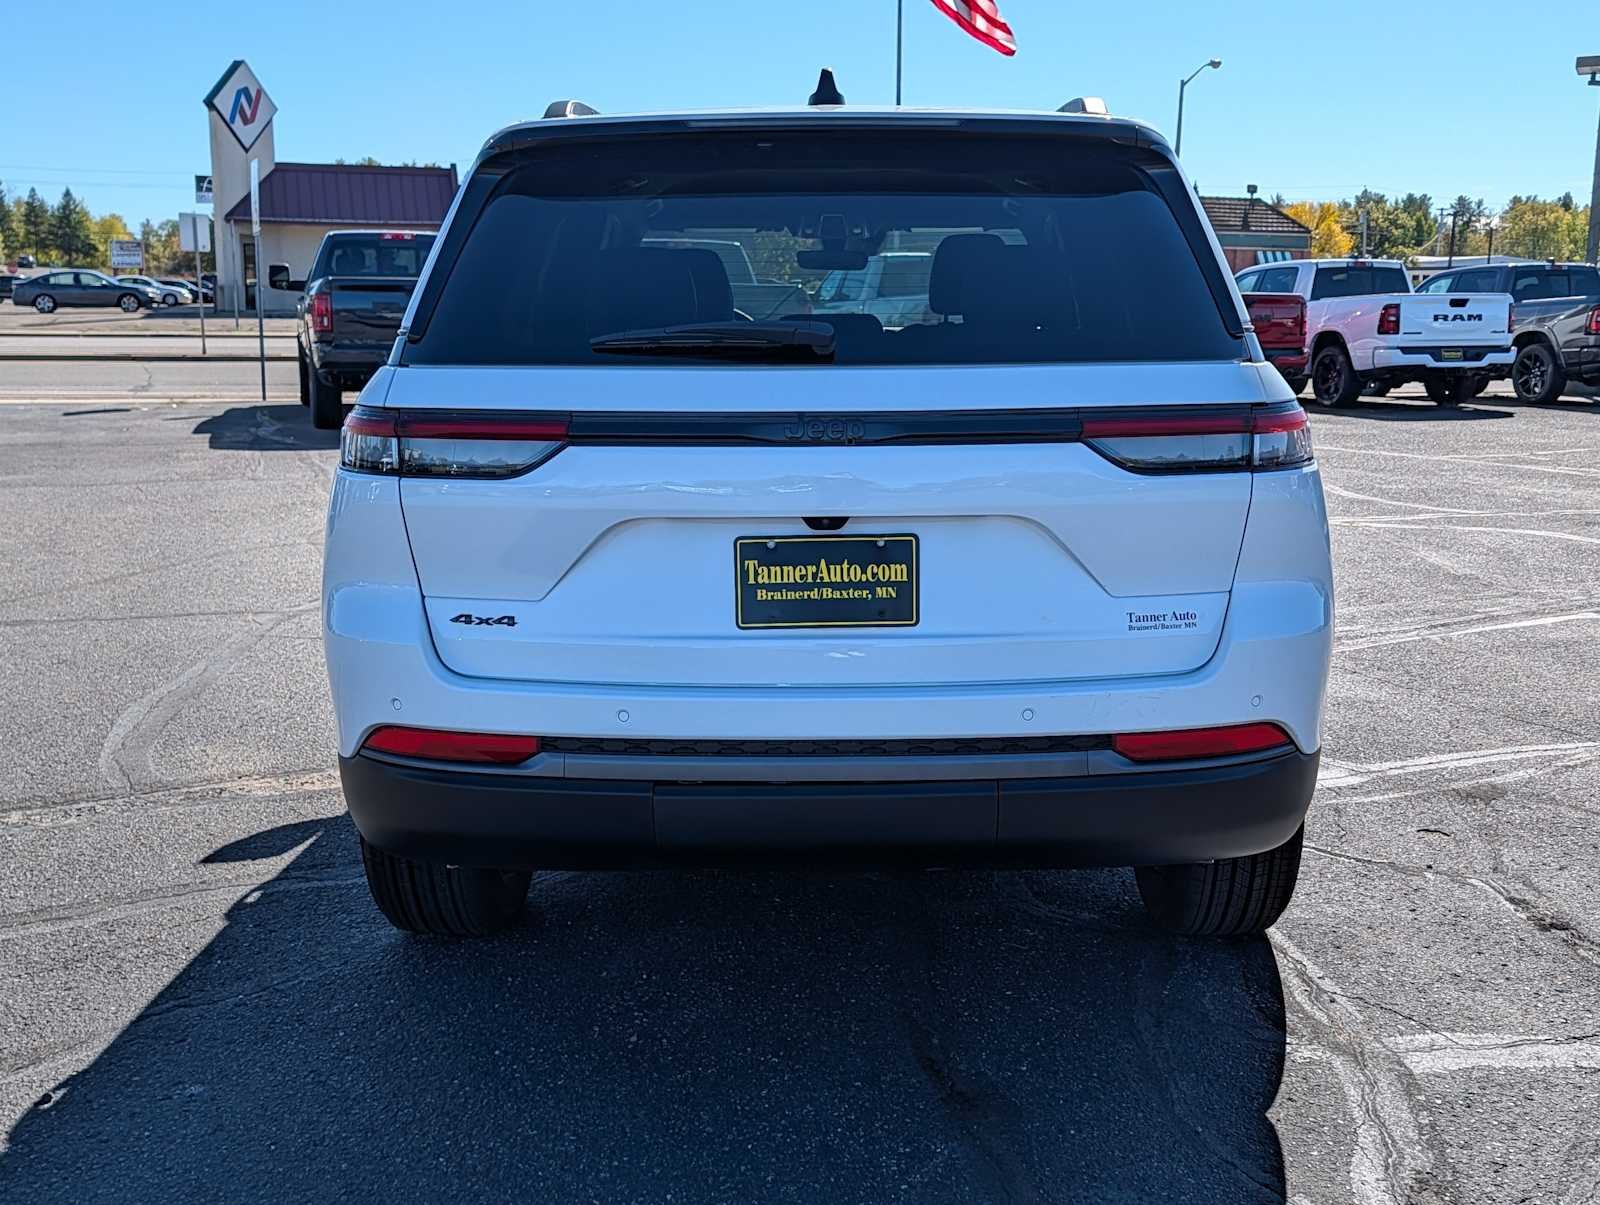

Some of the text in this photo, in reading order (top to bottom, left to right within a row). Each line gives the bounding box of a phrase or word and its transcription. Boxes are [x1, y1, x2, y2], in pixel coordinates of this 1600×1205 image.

[1433, 313, 1483, 322] RAM
[783, 416, 864, 445] Jeep
[744, 558, 908, 585] TannerAuto.com
[756, 586, 897, 601] Brainerd/Baxter, MN
[449, 614, 518, 627] 4x4
[1126, 610, 1197, 624] Tanner Auto
[1184, 621, 1198, 630] MN
